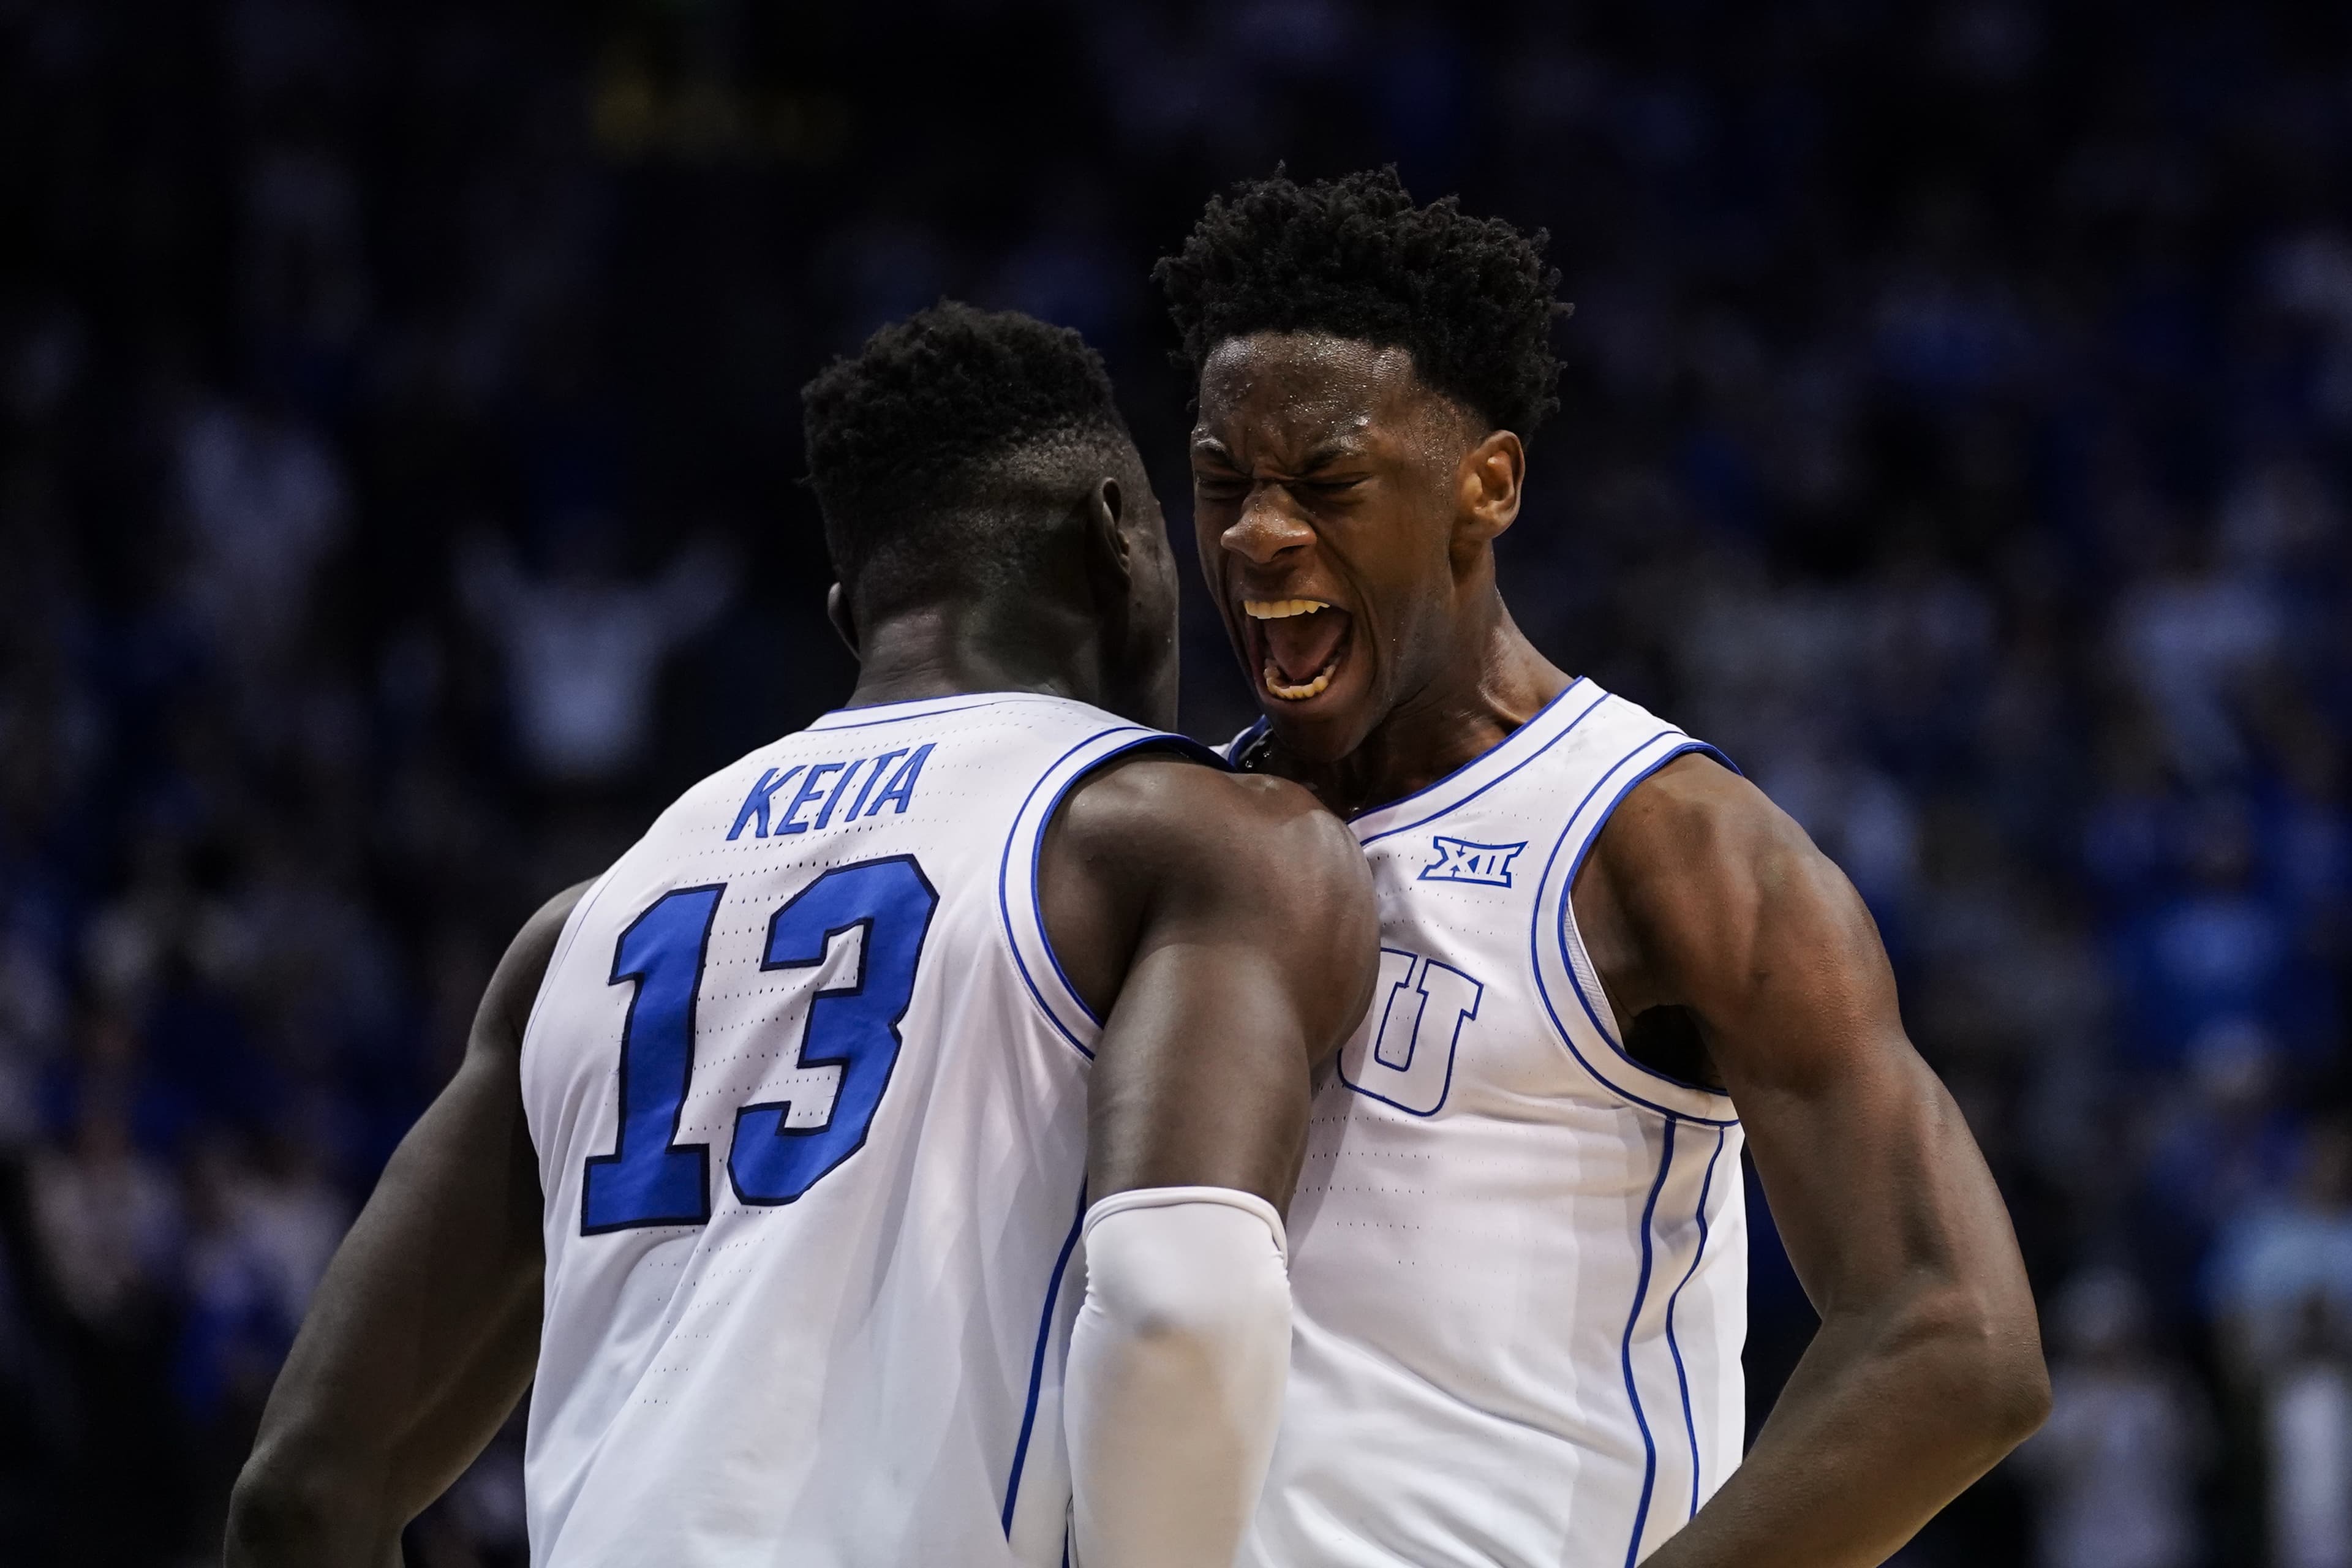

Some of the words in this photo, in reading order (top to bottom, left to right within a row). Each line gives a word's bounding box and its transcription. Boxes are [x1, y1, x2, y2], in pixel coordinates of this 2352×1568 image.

[726, 743, 936, 841] KEITA
[1417, 836, 1529, 888] XII
[581, 854, 940, 1236] 13
